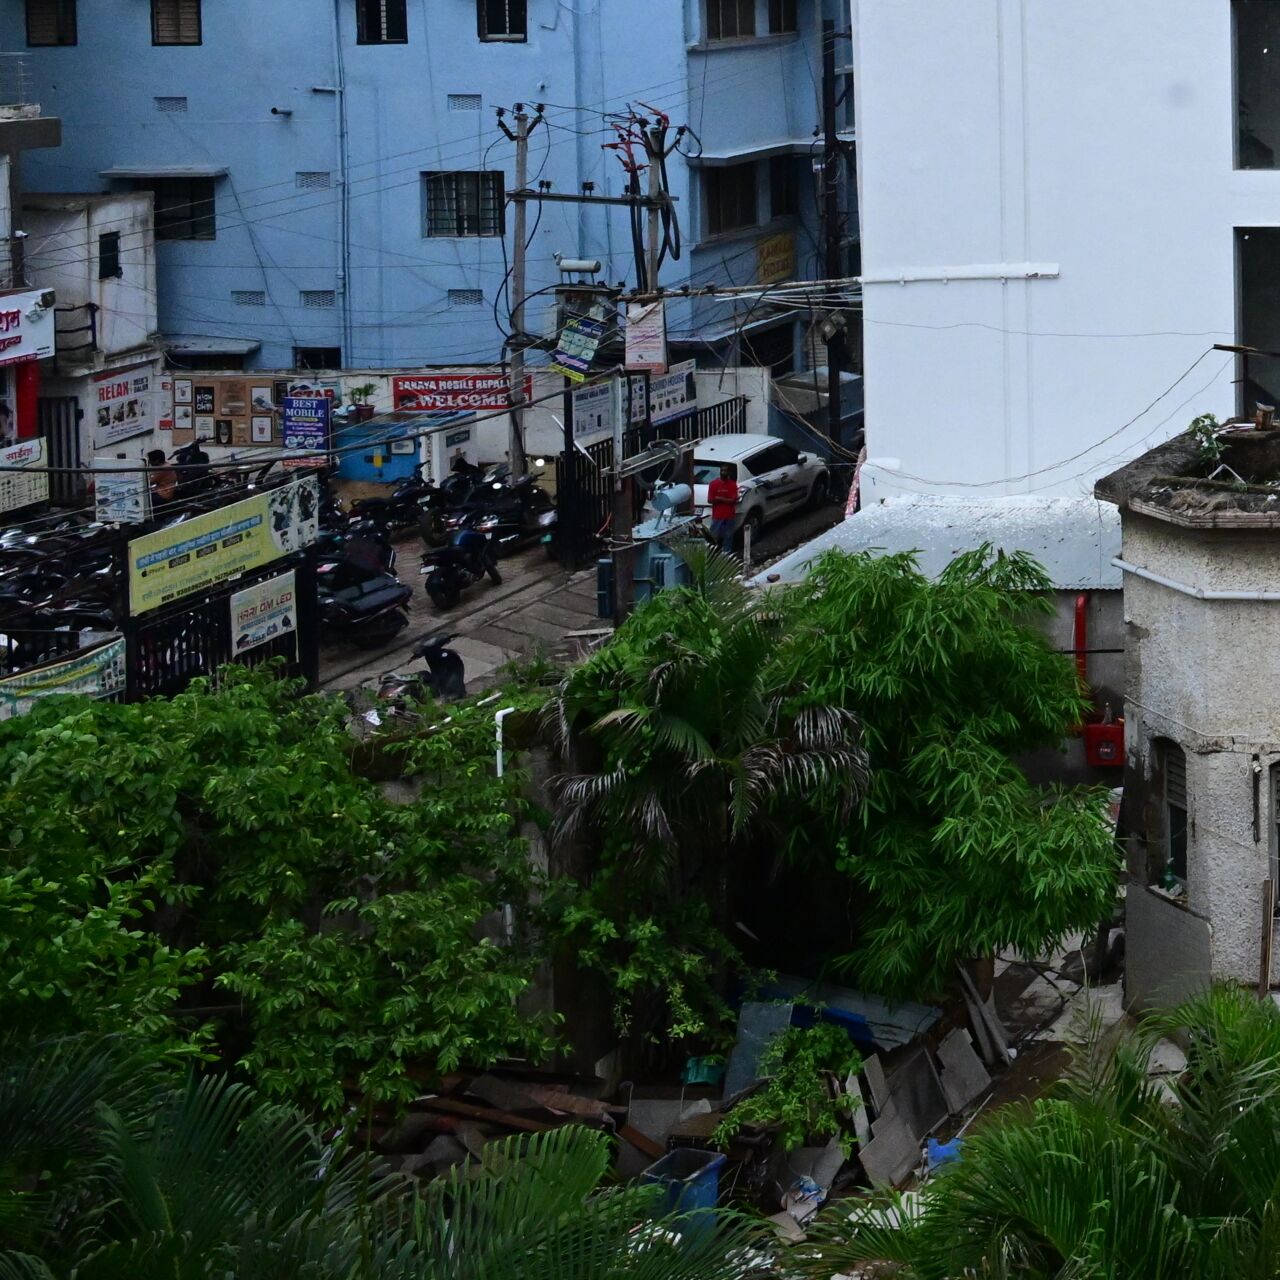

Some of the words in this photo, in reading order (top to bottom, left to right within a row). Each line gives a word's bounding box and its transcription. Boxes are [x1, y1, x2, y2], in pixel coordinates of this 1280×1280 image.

[293, 400, 319, 409] BEST
[418, 393, 509, 408] WELCOME
[285, 408, 325, 418] MOBILE
